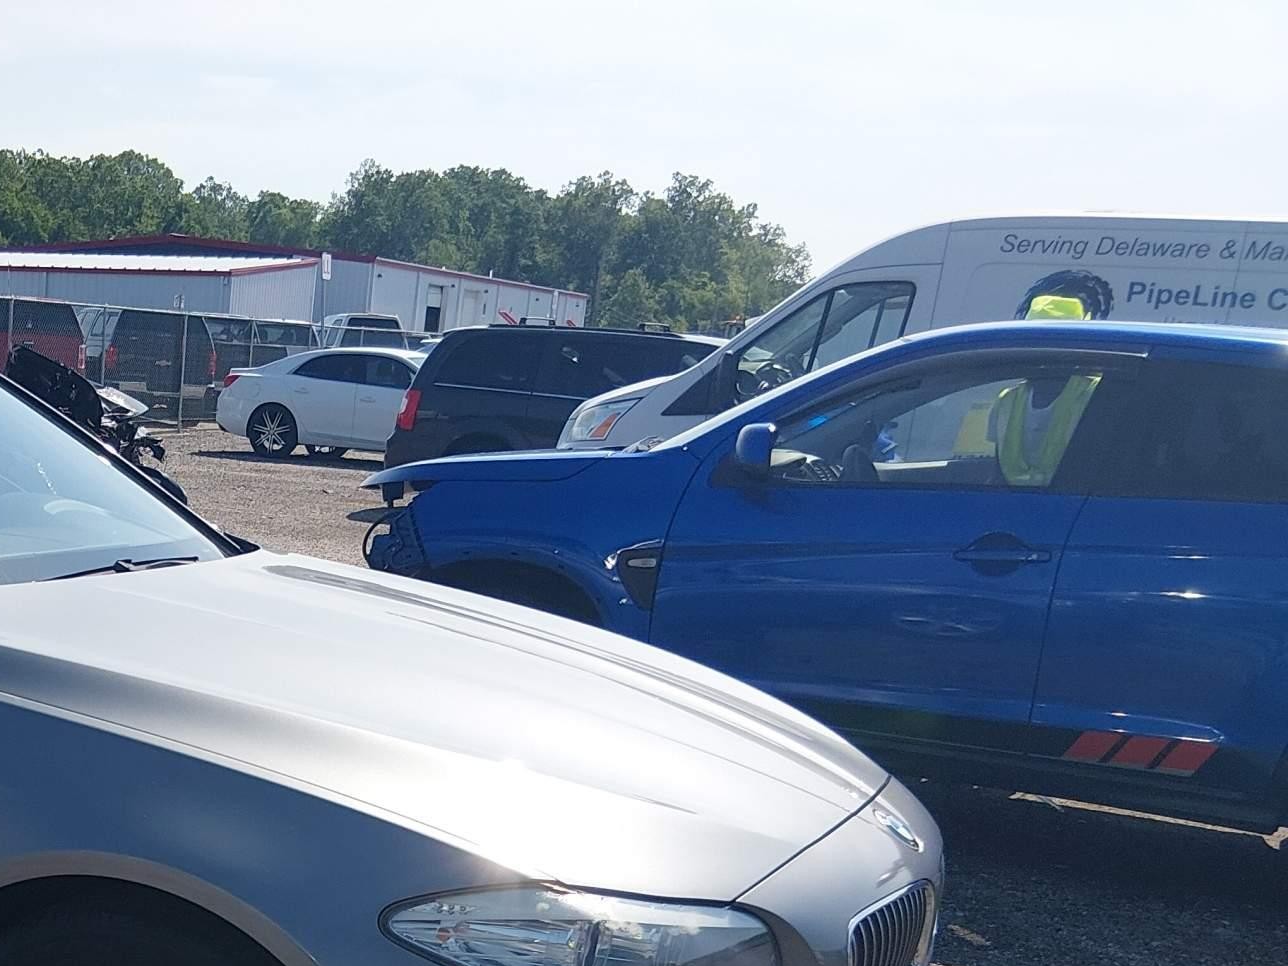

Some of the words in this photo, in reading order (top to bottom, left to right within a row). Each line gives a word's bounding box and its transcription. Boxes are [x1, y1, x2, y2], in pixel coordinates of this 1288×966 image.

[999, 233, 1090, 260] Serving
[1095, 235, 1211, 260] Delaware
[1218, 239, 1238, 260] &
[1126, 282, 1257, 310] PipeLine
